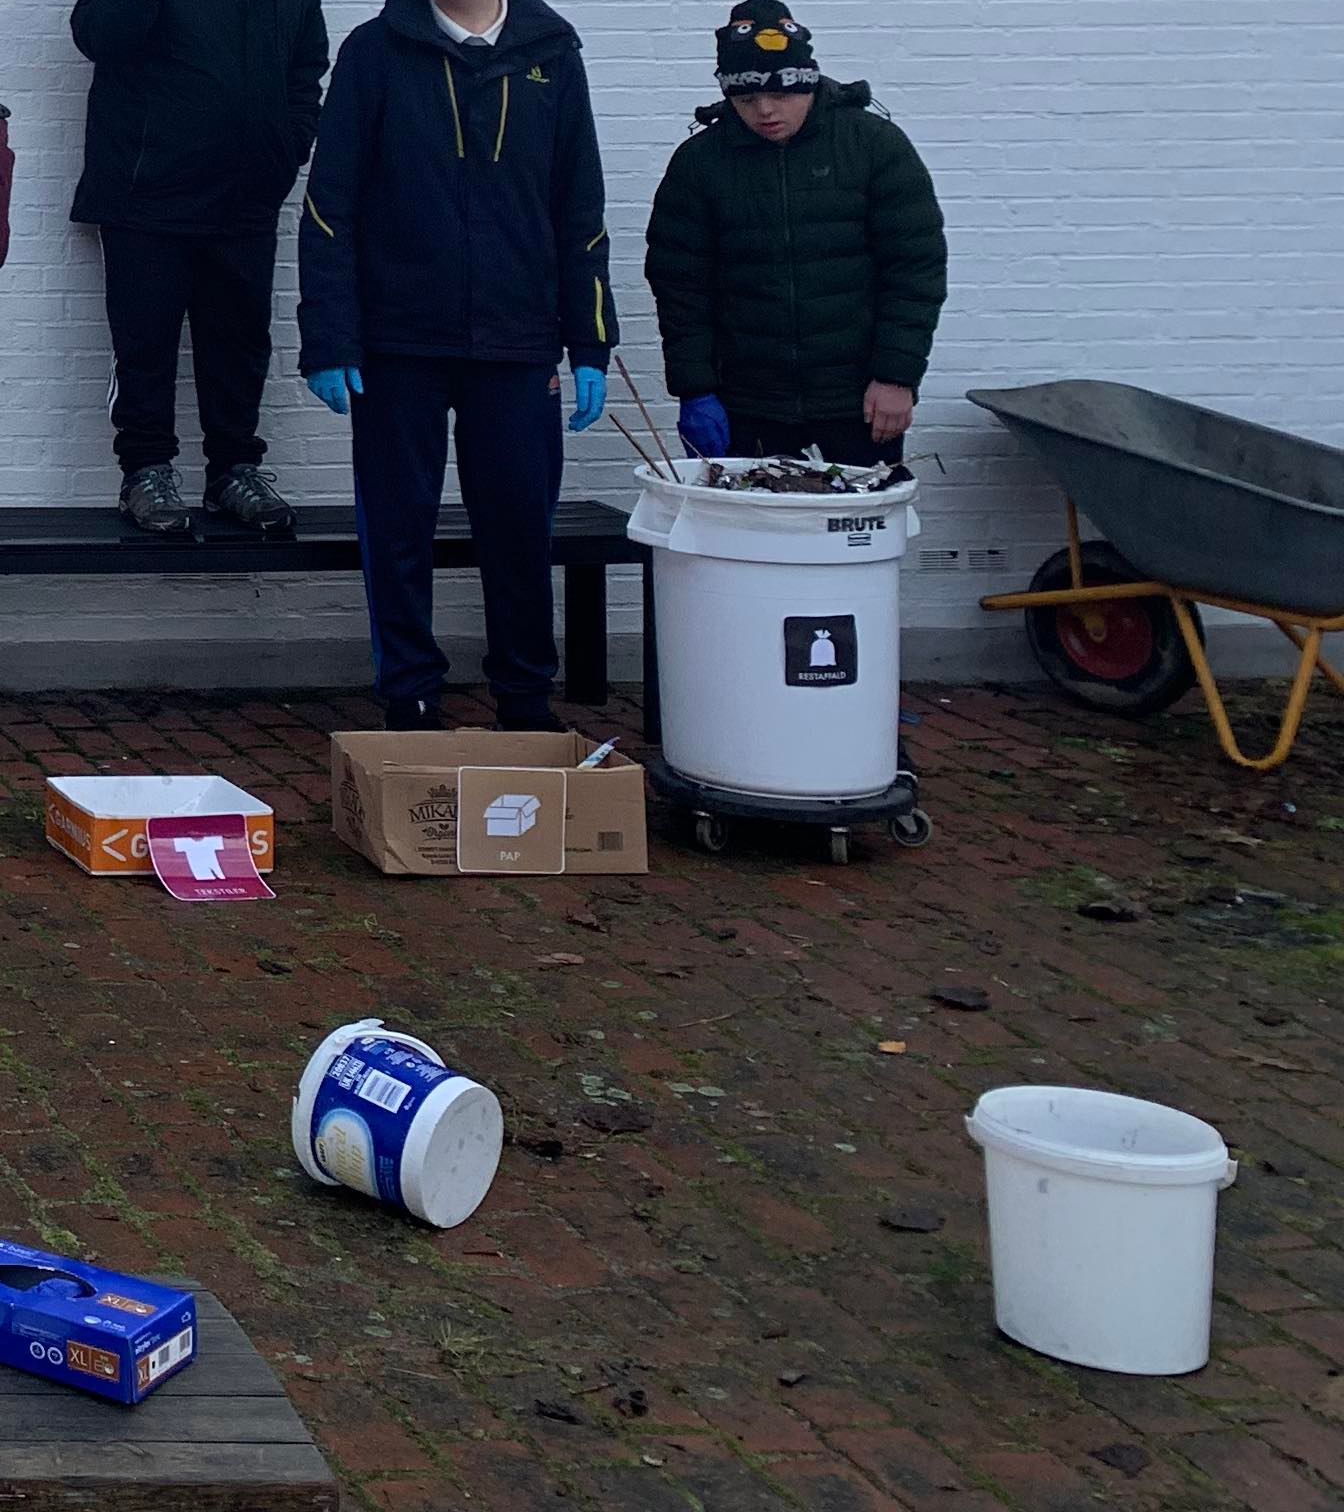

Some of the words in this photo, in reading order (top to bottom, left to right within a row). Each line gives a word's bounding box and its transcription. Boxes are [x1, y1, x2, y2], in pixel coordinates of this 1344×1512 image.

[827, 515, 887, 533] BRUTE
[798, 671, 847, 681] RESTAFFALD
[499, 850, 521, 862] PAP
[70, 1348, 88, 1367] XL
